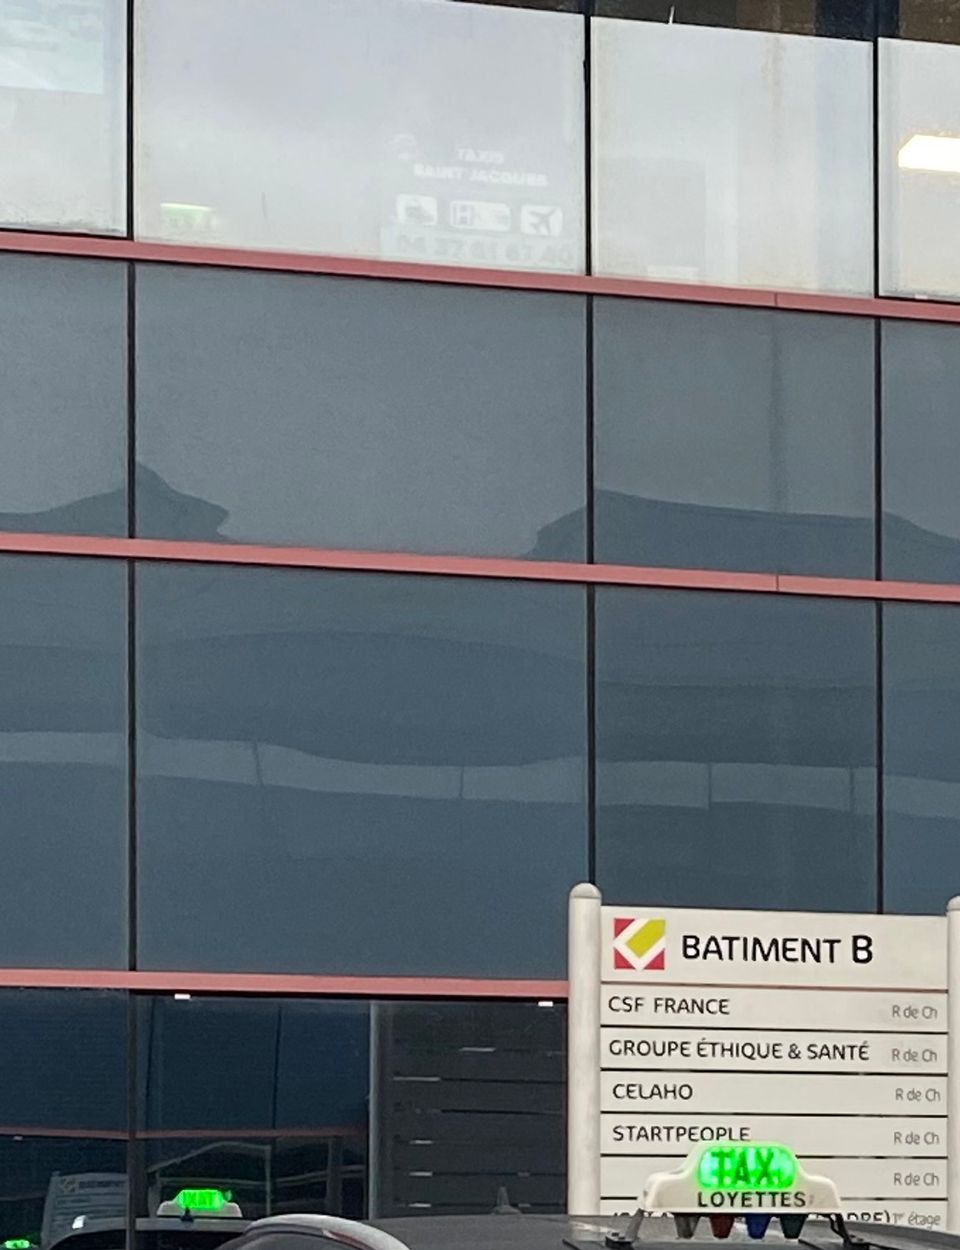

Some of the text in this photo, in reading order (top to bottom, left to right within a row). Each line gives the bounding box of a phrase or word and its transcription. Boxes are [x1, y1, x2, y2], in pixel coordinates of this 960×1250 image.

[681, 934, 874, 964] BATIMENT B
[608, 995, 730, 1015] CSF FRANCE
[892, 1004, 938, 1019] R de Ch
[609, 1037, 870, 1061] GROUPE ÉTHIQUE & SANTÉ
[892, 1048, 938, 1063] R de Ch
[612, 1083, 693, 1101] CELAHO
[895, 1088, 941, 1103] R de Ch
[612, 1124, 751, 1142] STARTPEOPLE
[893, 1131, 940, 1145] R de Ch
[893, 1172, 940, 1187] R de Ch
[698, 1190, 807, 1208] LOYETTES
[907, 1211, 942, 1231] étage
